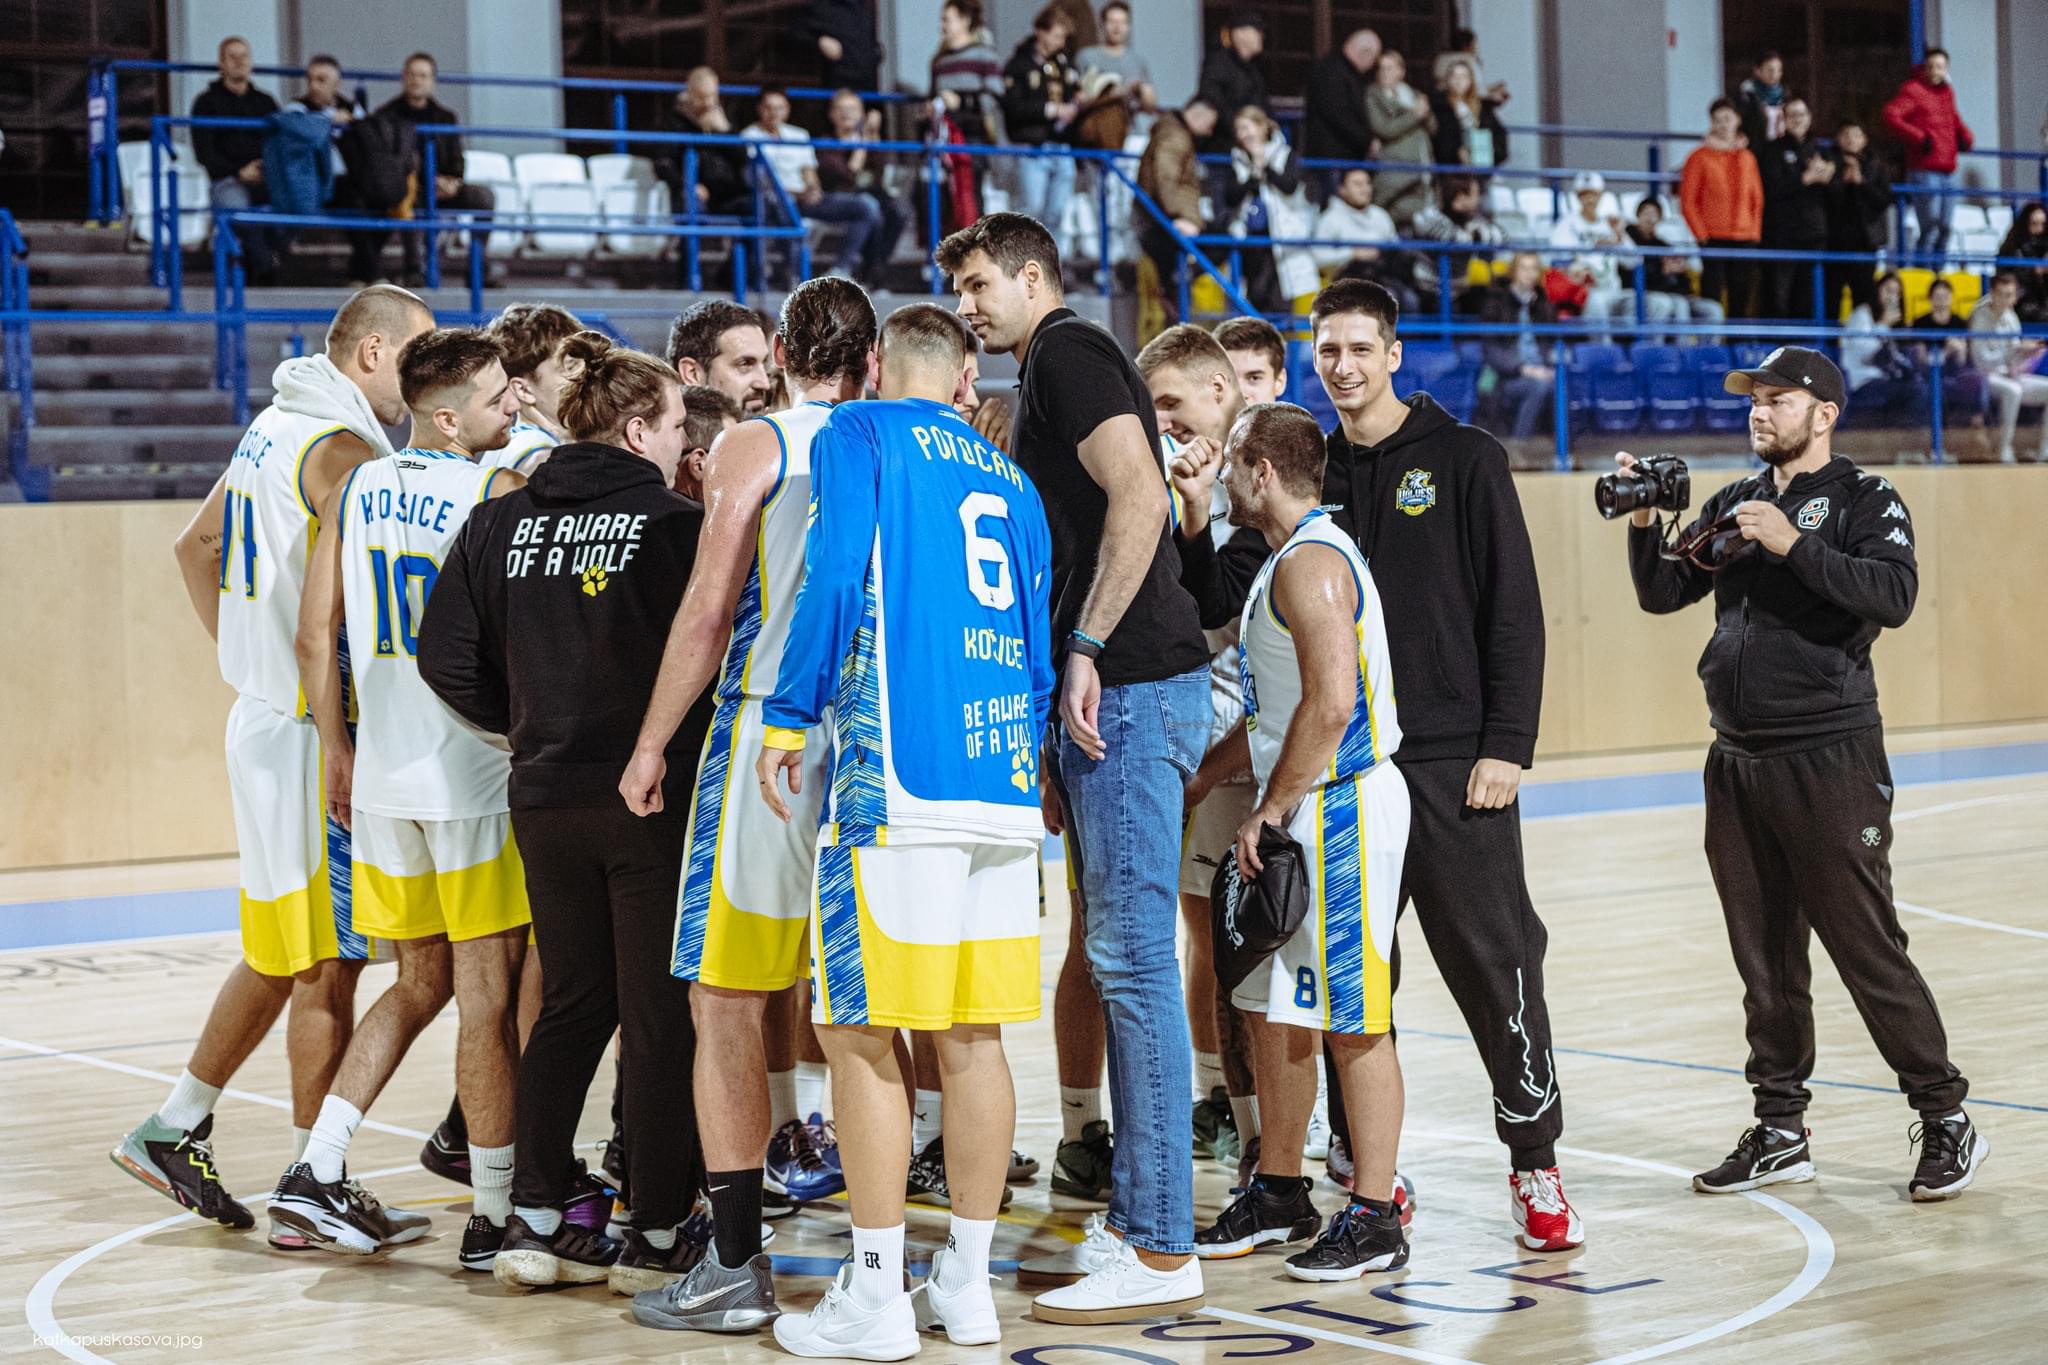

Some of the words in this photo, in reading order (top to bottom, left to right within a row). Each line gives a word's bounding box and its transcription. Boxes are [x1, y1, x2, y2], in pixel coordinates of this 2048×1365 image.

[511, 516, 550, 545] BE
[553, 513, 648, 543] AWARE
[506, 548, 540, 578] OF
[544, 546, 565, 576] A
[571, 543, 641, 575] WOLF
[958, 491, 1015, 611] 6
[367, 545, 442, 660] 10
[963, 700, 984, 729] BE
[966, 731, 984, 759] OF
[989, 728, 1001, 755] A
[1294, 965, 1317, 1009] 8
